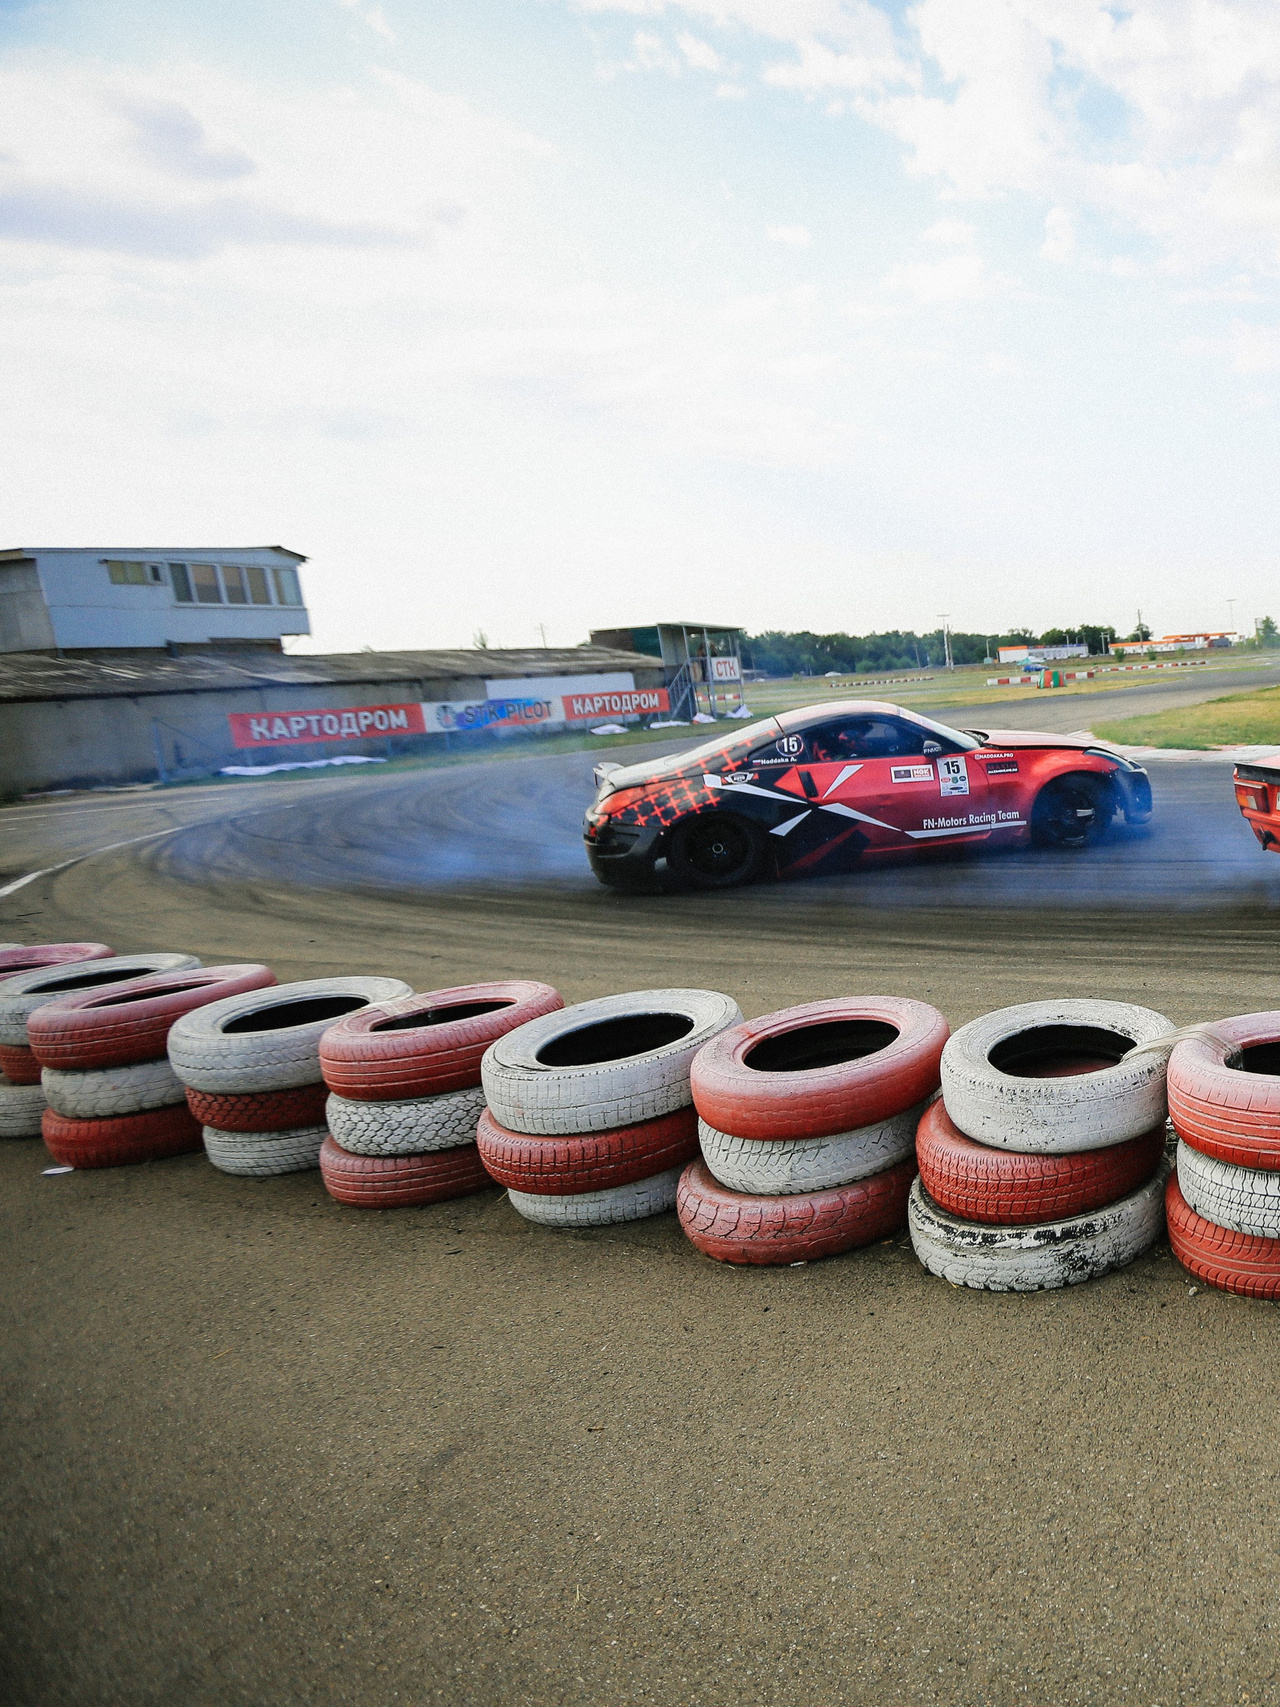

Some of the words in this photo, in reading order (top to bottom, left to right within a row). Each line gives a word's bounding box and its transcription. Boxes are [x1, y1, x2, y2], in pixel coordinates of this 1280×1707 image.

[464, 702, 499, 724] STK
[506, 701, 553, 720] PILOT
[572, 693, 660, 715] КАРТОДРОМ
[251, 709, 409, 741] КАРТОДРОМ
[782, 737, 798, 752] 15
[943, 761, 960, 774] 15
[923, 817, 967, 829] FN-Motors
[969, 812, 996, 823] Racing
[997, 810, 1019, 820] Team
